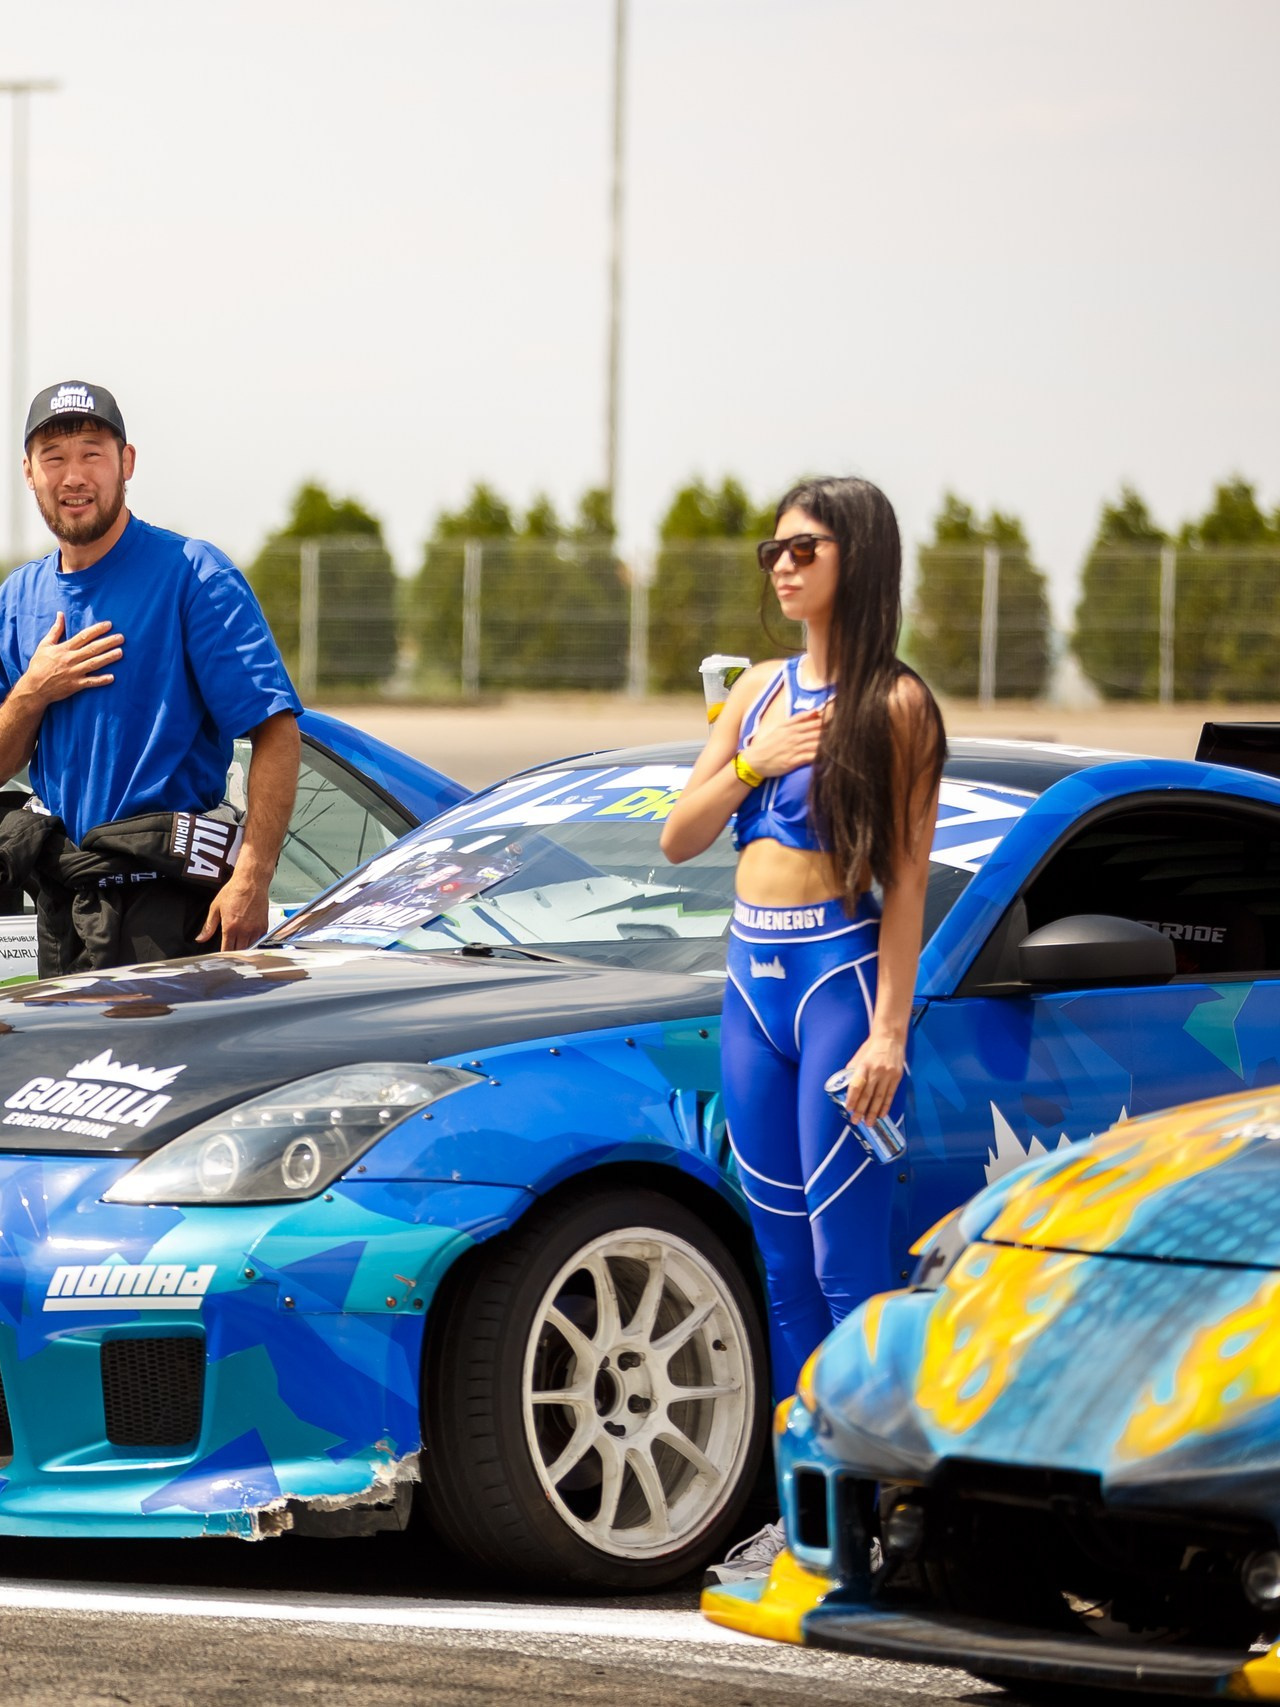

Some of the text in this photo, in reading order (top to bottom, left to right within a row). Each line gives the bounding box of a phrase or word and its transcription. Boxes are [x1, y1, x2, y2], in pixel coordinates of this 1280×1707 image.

[50, 395, 95, 410] GORILLA
[173, 818, 190, 855] DRINK
[187, 817, 229, 878] ILLA
[4, 1077, 172, 1128] GORILLA
[2, 1112, 117, 1139] ENERGY DRINK
